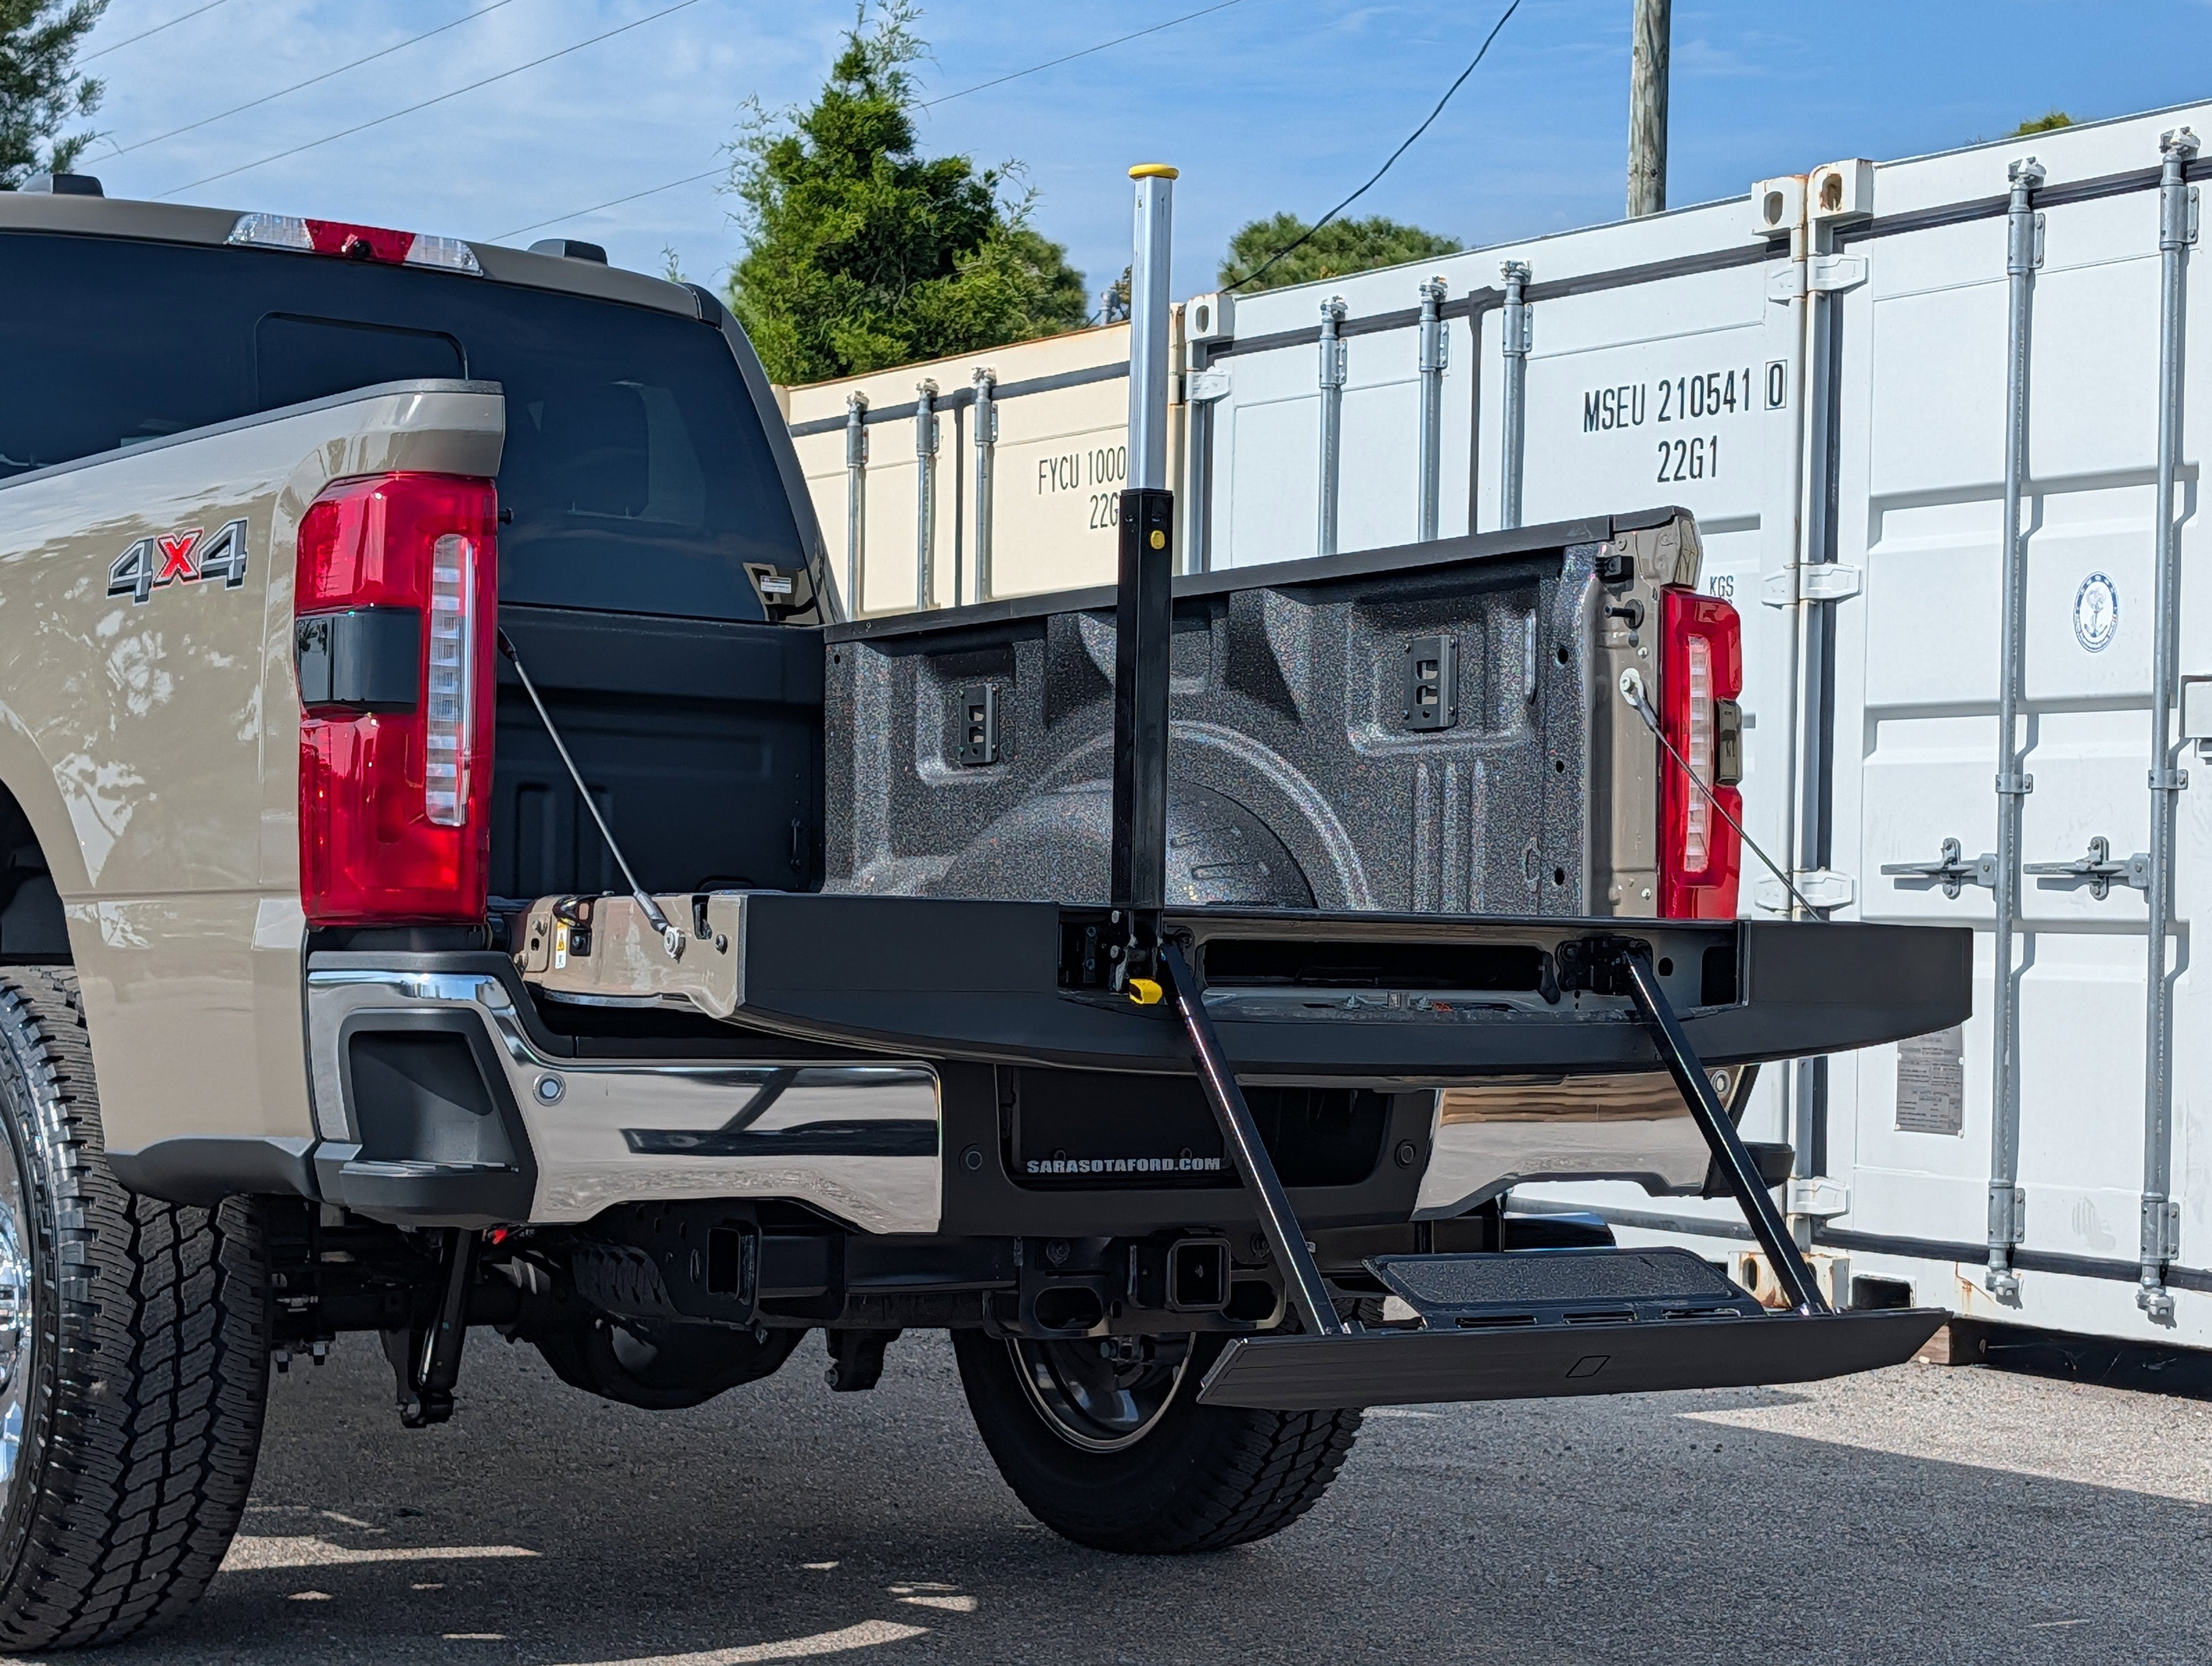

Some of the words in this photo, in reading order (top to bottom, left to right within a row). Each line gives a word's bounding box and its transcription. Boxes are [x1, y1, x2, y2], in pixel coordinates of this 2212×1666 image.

[1583, 384, 1645, 432] MSEU
[1657, 368, 1750, 421] 210541
[1769, 363, 1782, 406] 0
[1038, 453, 1079, 495] FYCU
[1657, 436, 1718, 482] 22G1
[1710, 575, 1733, 597] KGS
[1027, 1158, 1220, 1173] SARASOTAFORD.COM
